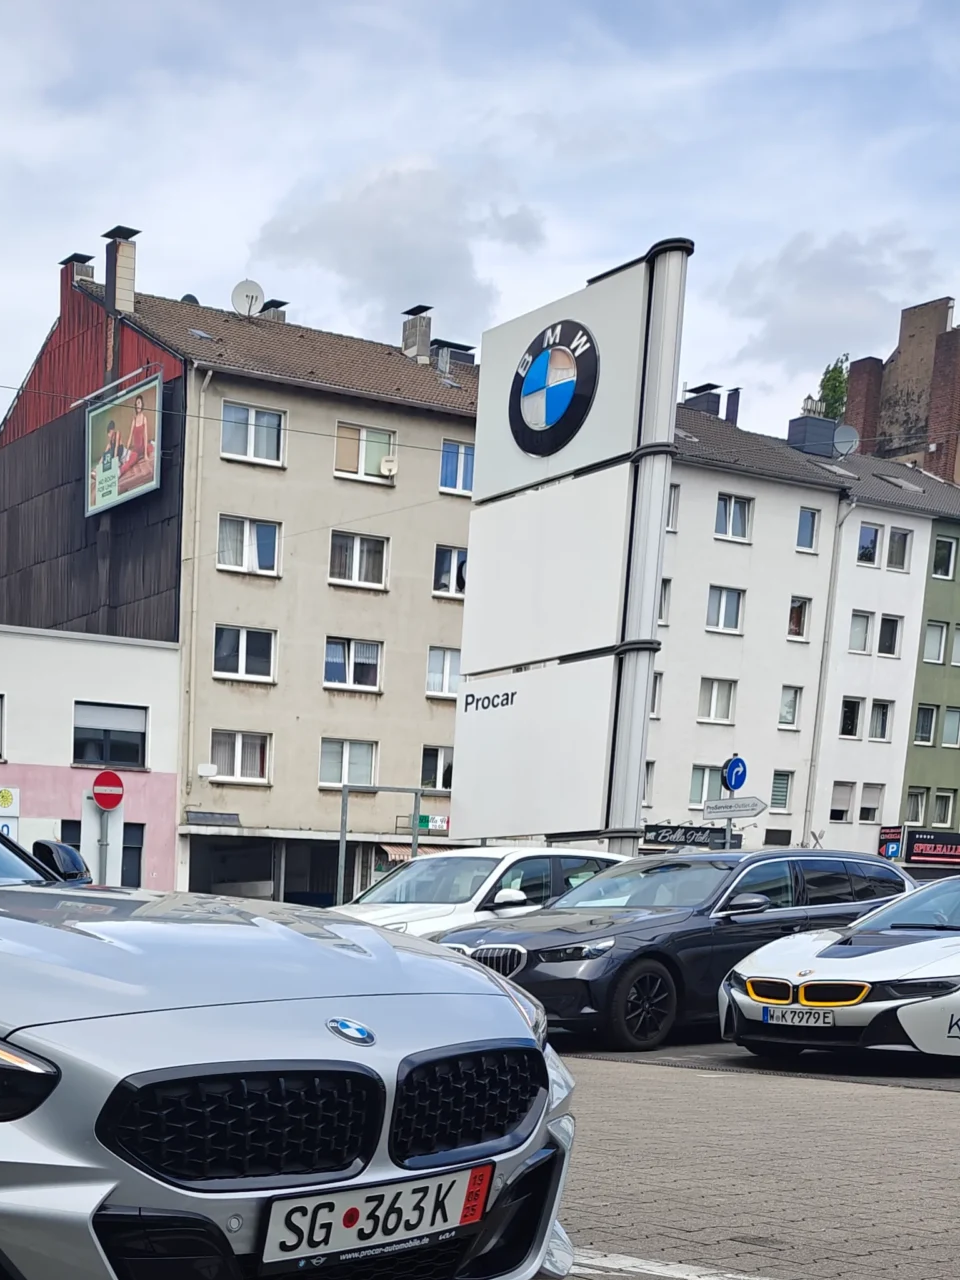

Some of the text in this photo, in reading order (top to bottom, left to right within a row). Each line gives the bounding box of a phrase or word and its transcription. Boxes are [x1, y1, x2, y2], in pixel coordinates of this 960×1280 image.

[517, 324, 590, 378] BMW
[464, 691, 517, 713] Procar
[657, 828, 685, 843] Bella
[889, 845, 897, 855] P
[279, 1201, 336, 1253] SG
[339, 1236, 430, 1261] www.procar-automobile.de
